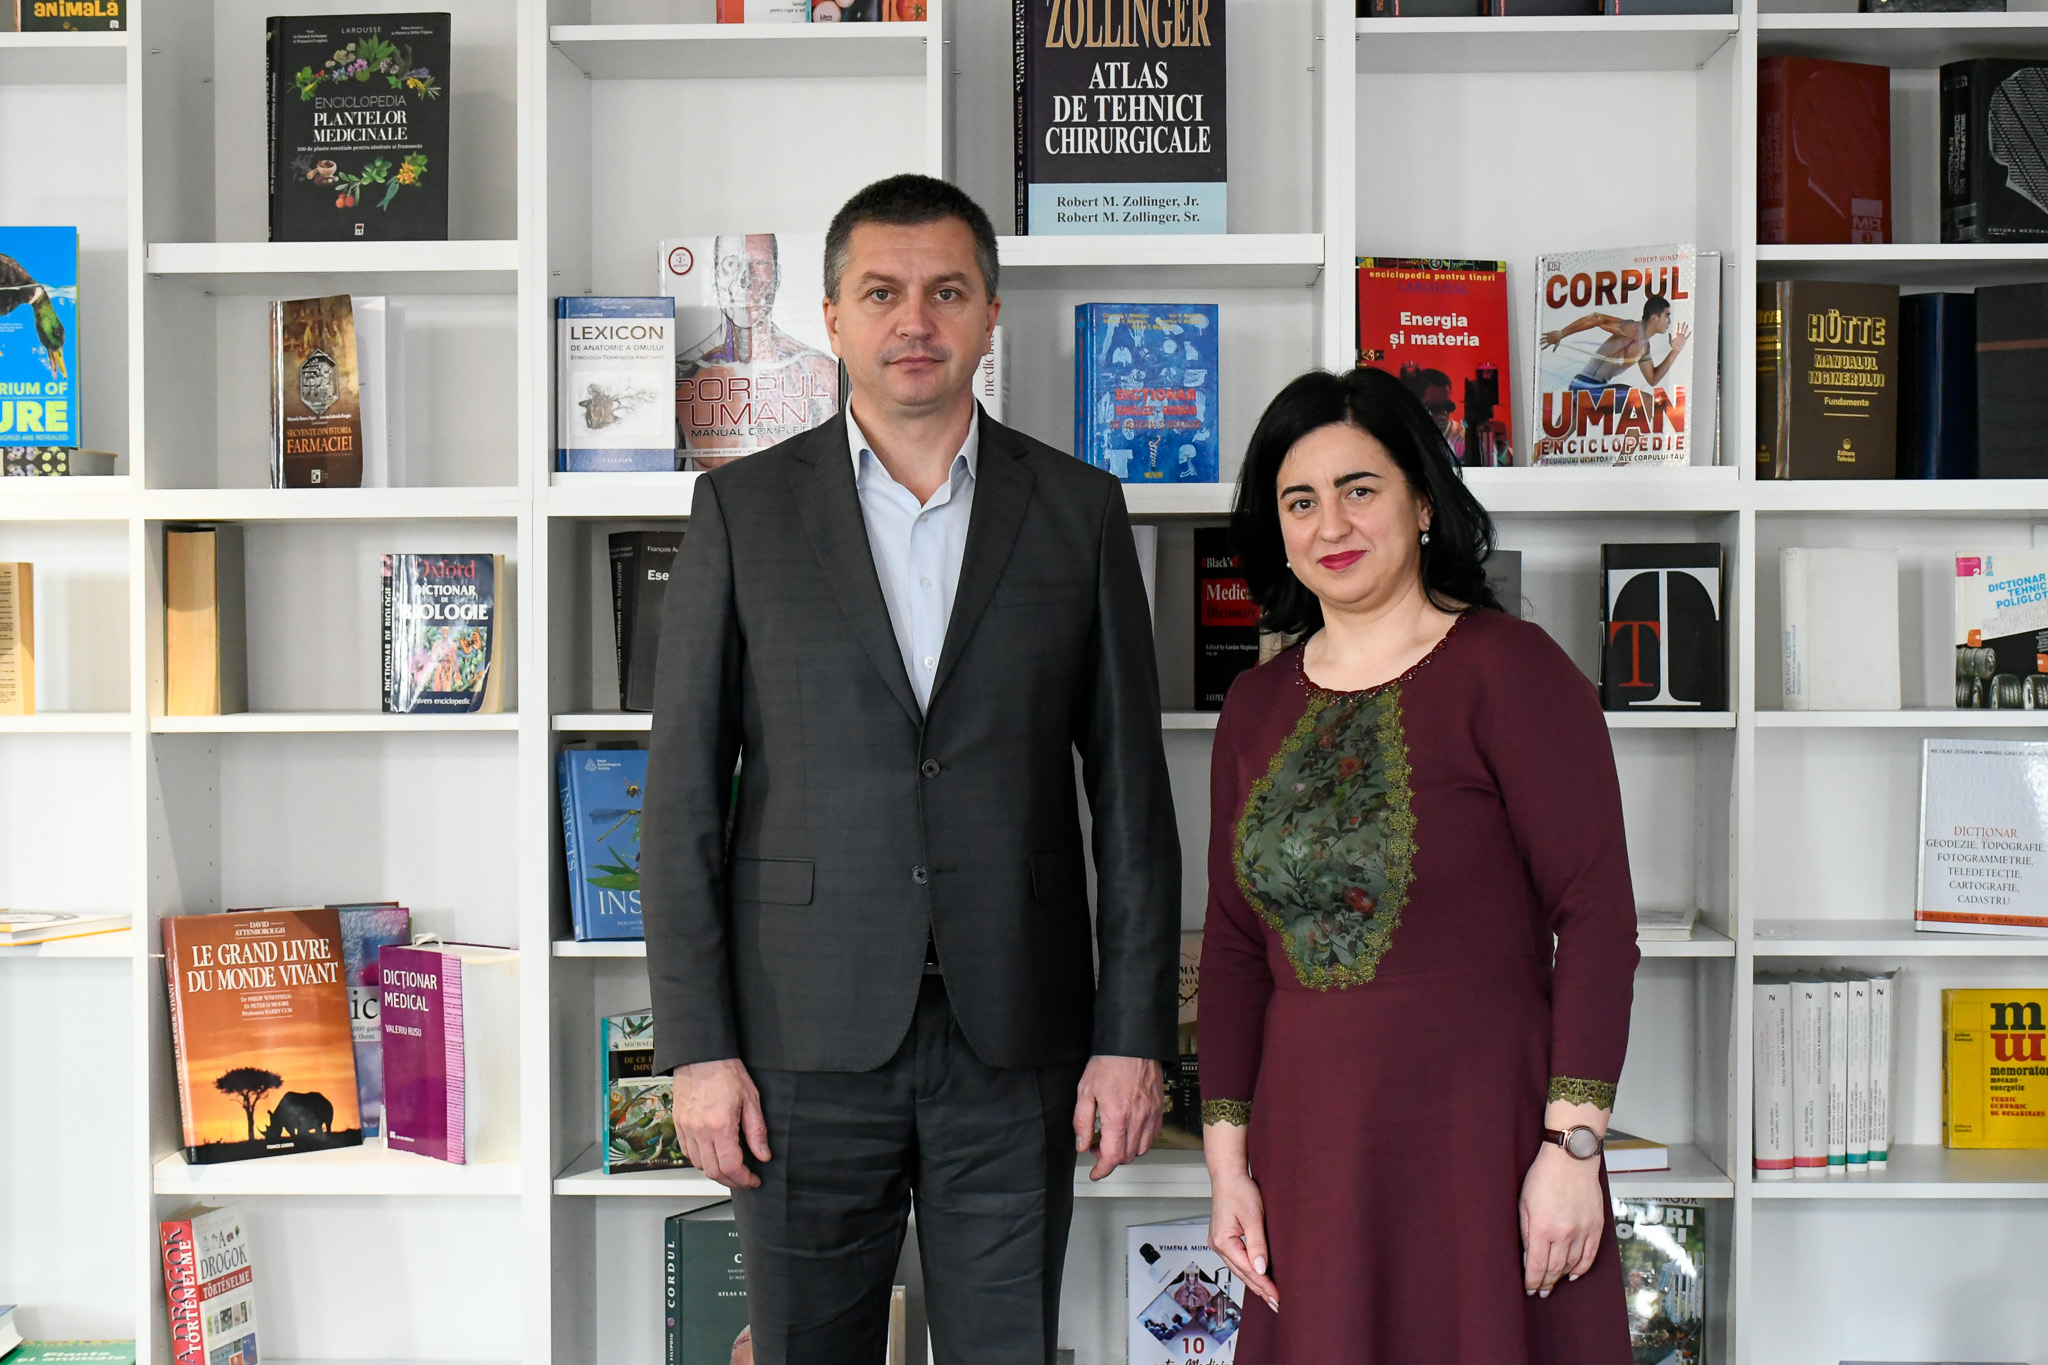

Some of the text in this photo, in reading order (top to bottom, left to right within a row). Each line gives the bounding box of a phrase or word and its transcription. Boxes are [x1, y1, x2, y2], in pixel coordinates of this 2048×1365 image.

[341, 26, 382, 34] LAROUSSE
[1045, 0, 1211, 48] ZOLLINGER
[1088, 61, 1168, 89] ATLAS
[315, 95, 407, 109] ENCICLOPEDIA
[1053, 94, 1203, 122] DE TEHNICI
[314, 110, 408, 126] PLANTELOR
[313, 127, 408, 142] MEDICINALE
[1045, 126, 1211, 154] CHIRURGICALE
[1057, 195, 1200, 209] Robert M. Zollinger, Jr.
[1057, 211, 1200, 225] Robert M. Zollinger, Sr.
[1853, 217, 1881, 230] MR
[1863, 232, 1872, 244] 3
[1634, 254, 1688, 264] ROBERT WINSTON
[1369, 271, 1495, 282] enciclopedia pentru tineri
[1398, 282, 1468, 295] LAROUSSE
[1546, 266, 1689, 309] CORPUL
[1400, 311, 1468, 330] Energia
[1807, 309, 1886, 346] HÜTTE
[571, 325, 664, 340] LEXICON
[1389, 330, 1480, 350] și materia
[1814, 354, 1878, 371] MANUALUL
[1808, 370, 1885, 388] INGINERULUI
[45, 382, 68, 395] OF
[675, 375, 829, 402] CORPUL
[1115, 388, 1197, 404] DICȚIONAR
[1116, 403, 1197, 416] ENGLEZ ROMÂN
[1824, 396, 1870, 407] Fundamente
[690, 401, 808, 427] UMAN
[1542, 384, 1686, 438] UMAN
[317, 427, 329, 436] DIN
[329, 426, 352, 434] ISTORIA
[691, 428, 744, 437] MANUAL
[287, 436, 353, 453] FARMACIEI
[1541, 436, 1685, 455] ENCICLOPEDIE
[1634, 454, 1669, 462] CORPULUI
[1206, 557, 1233, 568] Black's
[647, 569, 670, 581] Ese
[414, 585, 476, 597] DICȚIONAR
[2008, 582, 2048, 597] TEHNIC
[1996, 591, 2048, 609] POLIGLOT
[1608, 567, 1720, 706] T
[1609, 621, 1661, 687] T
[434, 697, 471, 705] enciclopedic
[561, 787, 576, 872] INSECTS
[1954, 826, 2018, 839] DICȚIONAR
[1926, 839, 2046, 852] GEODEZIE, TOPOGRAFIE,
[1937, 853, 2034, 866] FOTOGRAMMETRIE,
[1948, 867, 2023, 880] TELEDETECȚIE,
[1949, 881, 2020, 893] CARTOGRAFIE,
[599, 890, 641, 915] INS
[1957, 895, 2010, 905] CADASTRU
[235, 927, 285, 937] ATTENBOROUGH
[250, 921, 269, 929] DAVID
[192, 945, 214, 967] LE
[217, 941, 278, 966] GRAND
[282, 938, 331, 962] LIVRE
[187, 962, 339, 993] DU MONDE VIVANT
[383, 969, 437, 990] DICȚIONAR
[168, 983, 176, 1015] VIVANT
[351, 990, 378, 1020] ic
[384, 992, 429, 1012] MEDICAL
[1990, 1002, 2046, 1031] m
[385, 1024, 422, 1037] VALERIU RUSU
[1990, 1067, 2048, 1076] memorator
[1990, 1085, 2025, 1093] energetic
[218, 1231, 226, 1249] A
[200, 1244, 247, 1280] DROGOK
[667, 1241, 676, 1309] CORDUL
[164, 1227, 192, 1341] DROGOK
[203, 1270, 250, 1300] TÖRTÉNELME
[180, 1240, 202, 1351] TÖRTÉNELME
[1182, 1337, 1205, 1354] 10
